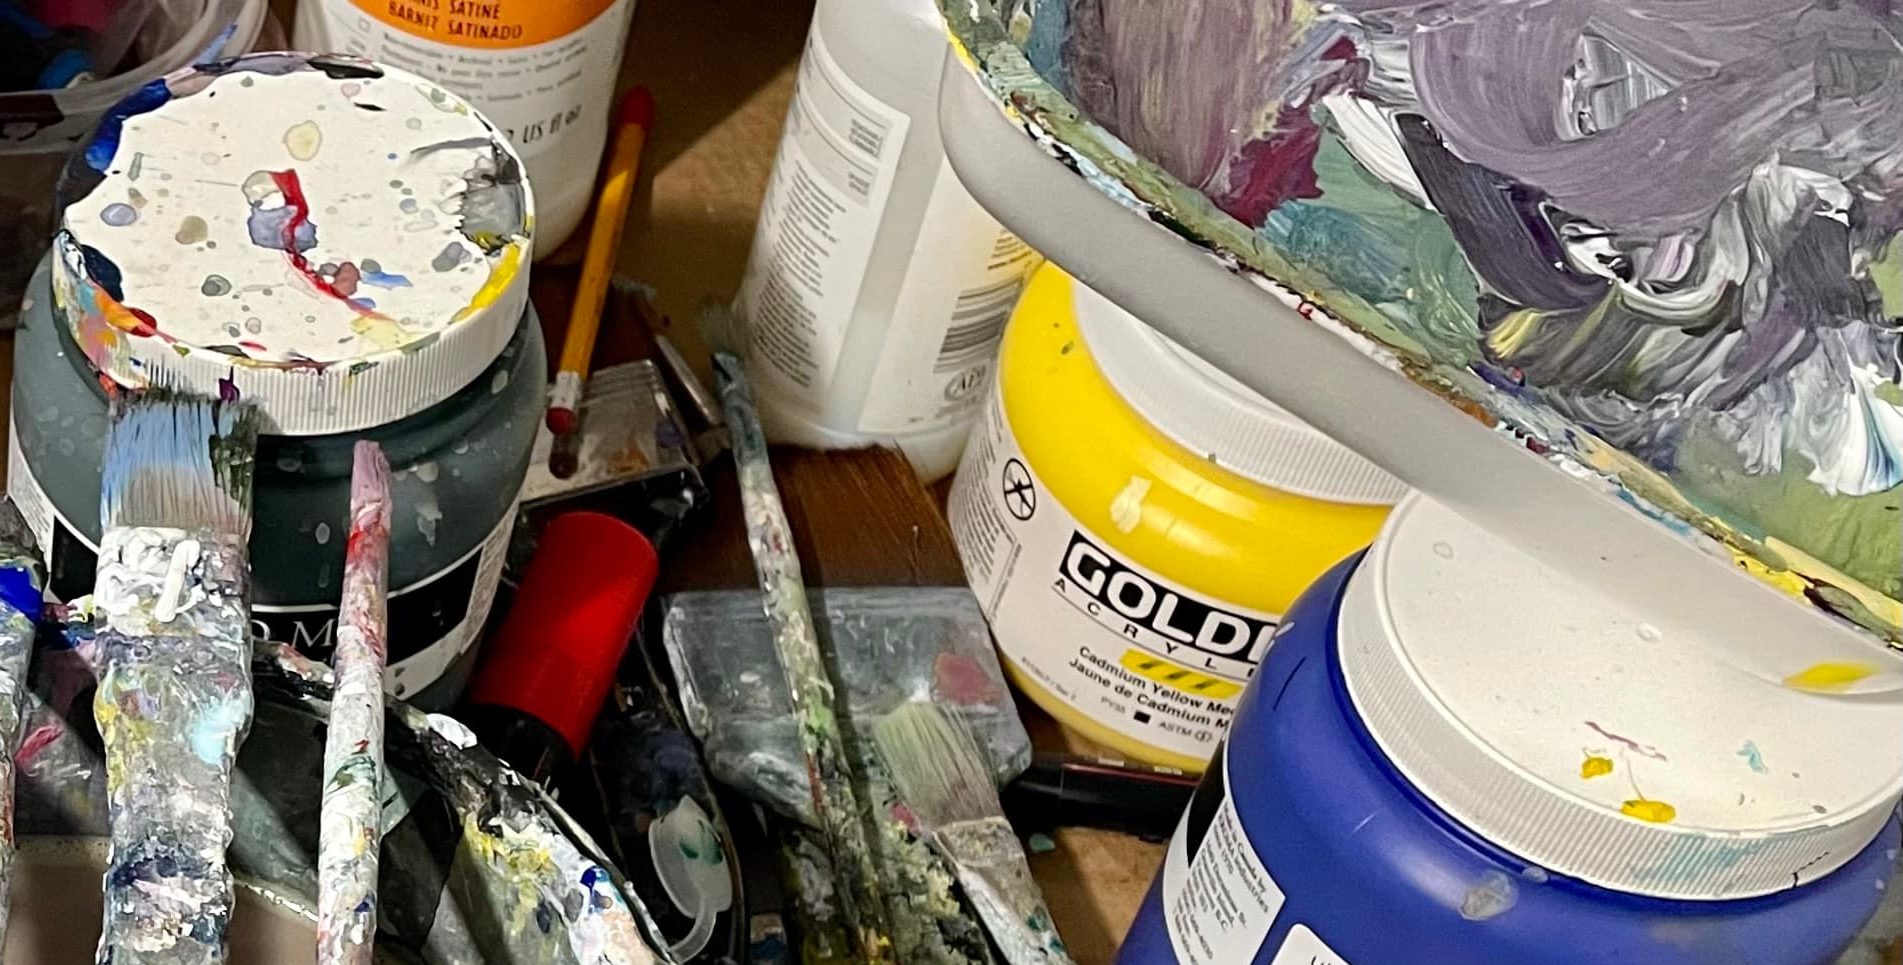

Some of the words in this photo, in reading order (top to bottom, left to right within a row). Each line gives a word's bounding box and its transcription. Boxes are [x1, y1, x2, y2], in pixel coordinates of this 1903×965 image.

[448, 20, 523, 41] SATINADO
[1054, 577, 1256, 678] ACRYLI
[1065, 541, 1275, 666] GOLD
[1068, 659, 1112, 689] Jaune
[1114, 682, 1134, 699] de
[1136, 693, 1212, 726] Cadmium
[1079, 645, 1146, 689] Cadmium
[1152, 676, 1203, 709] Yellow
